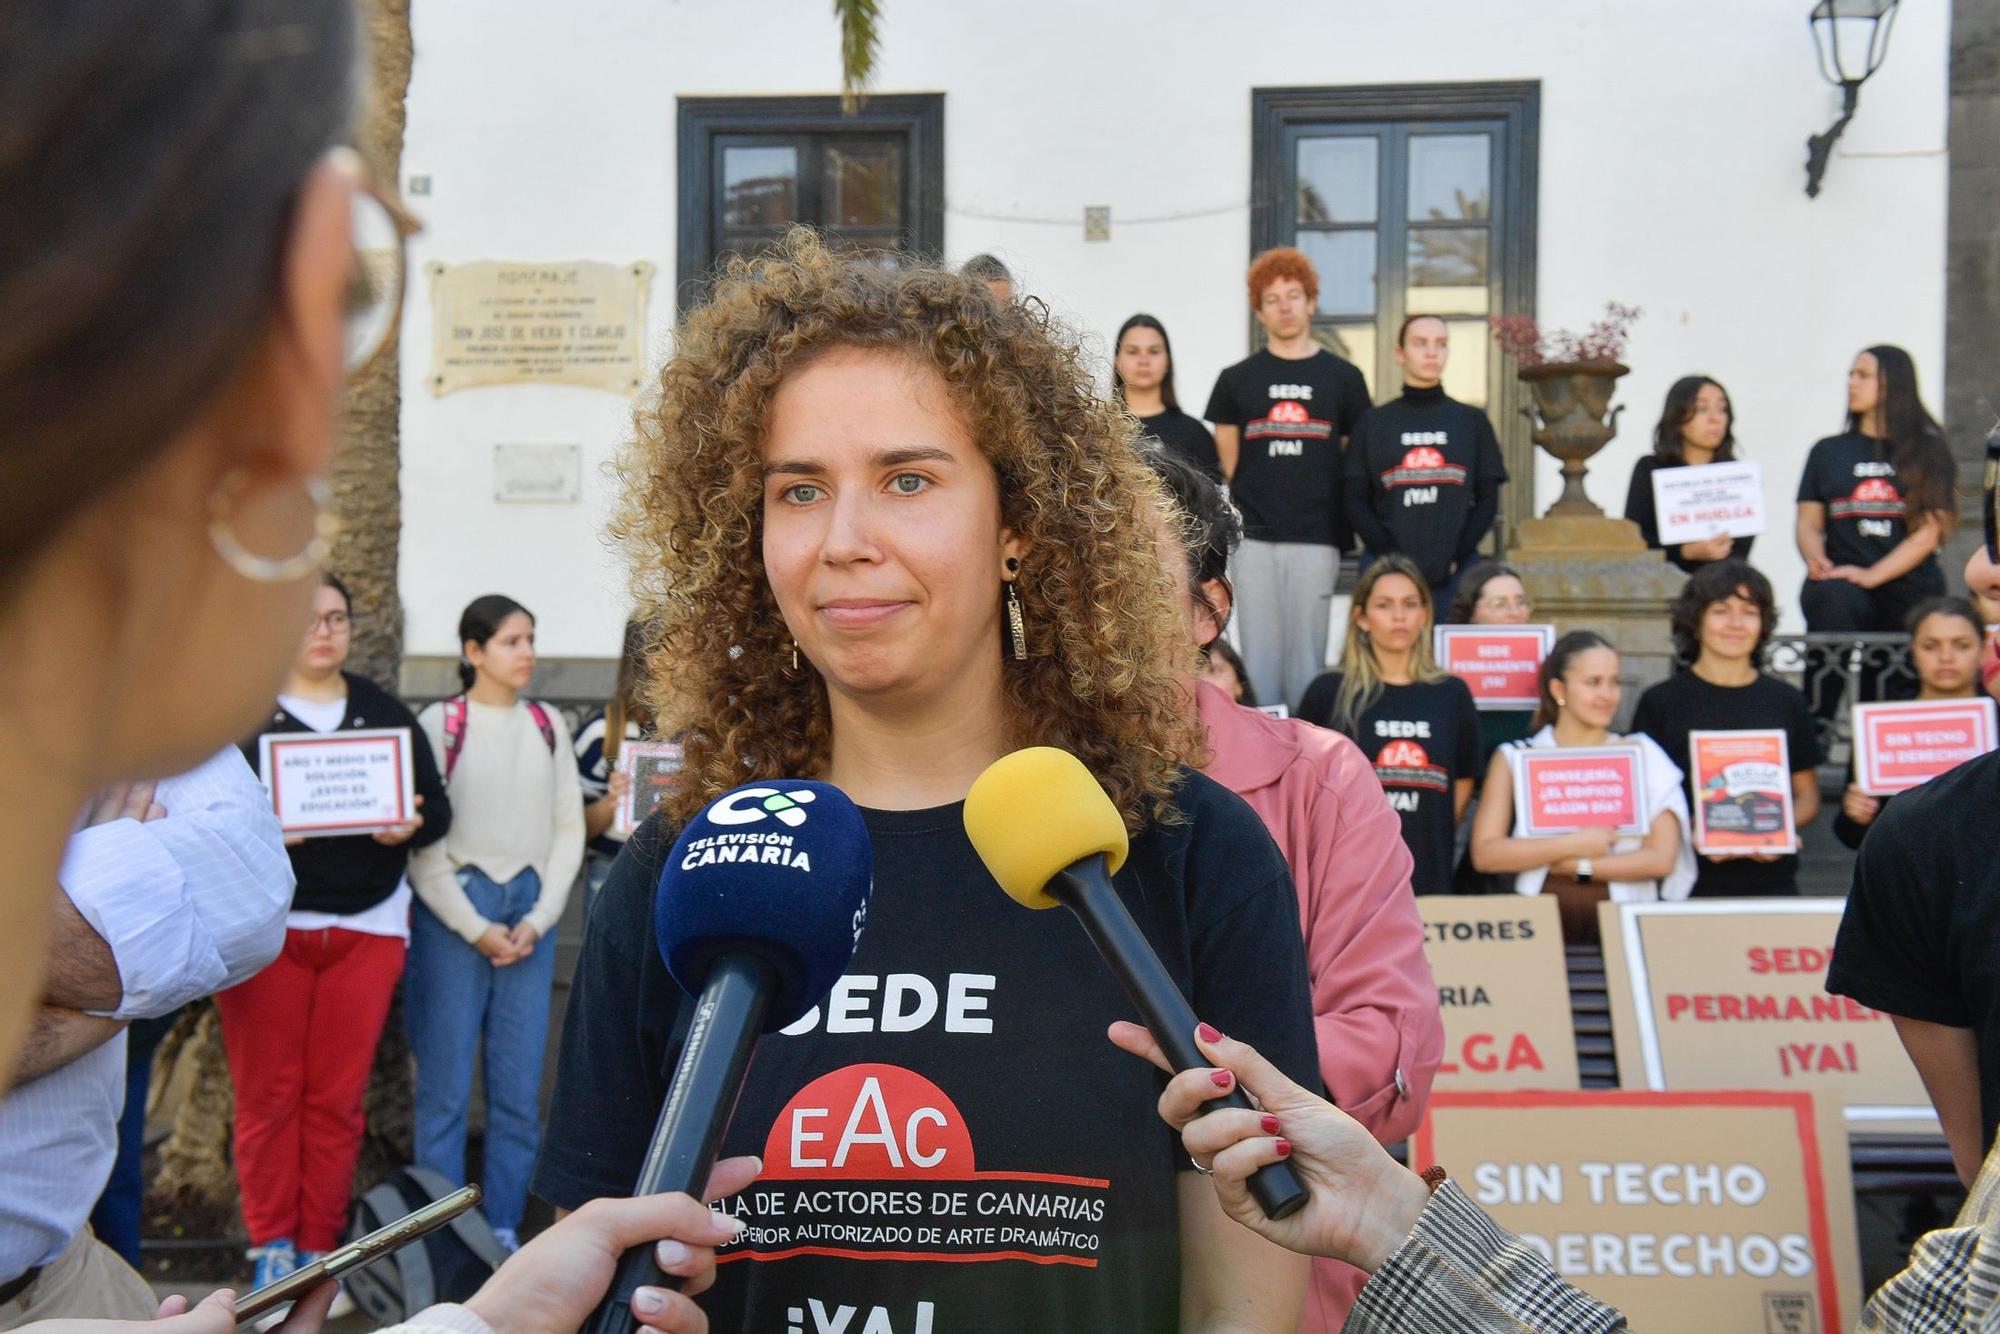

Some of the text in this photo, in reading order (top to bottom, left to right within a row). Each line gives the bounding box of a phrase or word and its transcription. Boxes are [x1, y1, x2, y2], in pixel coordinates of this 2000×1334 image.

[1268, 384, 1313, 400] SEDE
[1268, 439, 1303, 457] ¡YA!
[1401, 431, 1448, 446] SEDE
[1403, 486, 1438, 507] ¡YA!
[1669, 505, 1754, 525] EN HUELGA
[1477, 645, 1511, 658] SEDE
[1452, 660, 1536, 673] PERMANENTE
[1375, 720, 1431, 738] SEDE
[1886, 730, 1968, 746] SIN TECHO
[315, 757, 322, 765] Y
[326, 754, 366, 765] MEDIO
[1386, 791, 1419, 812] YA!
[688, 832, 794, 852] TELEVISIÓN
[681, 845, 811, 872] CANARIA
[1747, 947, 1834, 974] SED
[1666, 994, 1888, 1022] PERMANE
[1779, 1041, 1858, 1077] ¡YA!
[790, 1077, 947, 1168] EAC
[1474, 1162, 1767, 1206] SIN TECHO
[755, 1192, 785, 1215] DE
[793, 1191, 922, 1215] ACTORES
[931, 1192, 967, 1216] DE
[977, 1192, 1105, 1222] CANARIAS
[795, 1224, 912, 1244] AUTORIZADO
[917, 1228, 941, 1244] DE
[947, 1228, 995, 1245] ARTE
[1000, 1227, 1099, 1250] DRAMÁTICO
